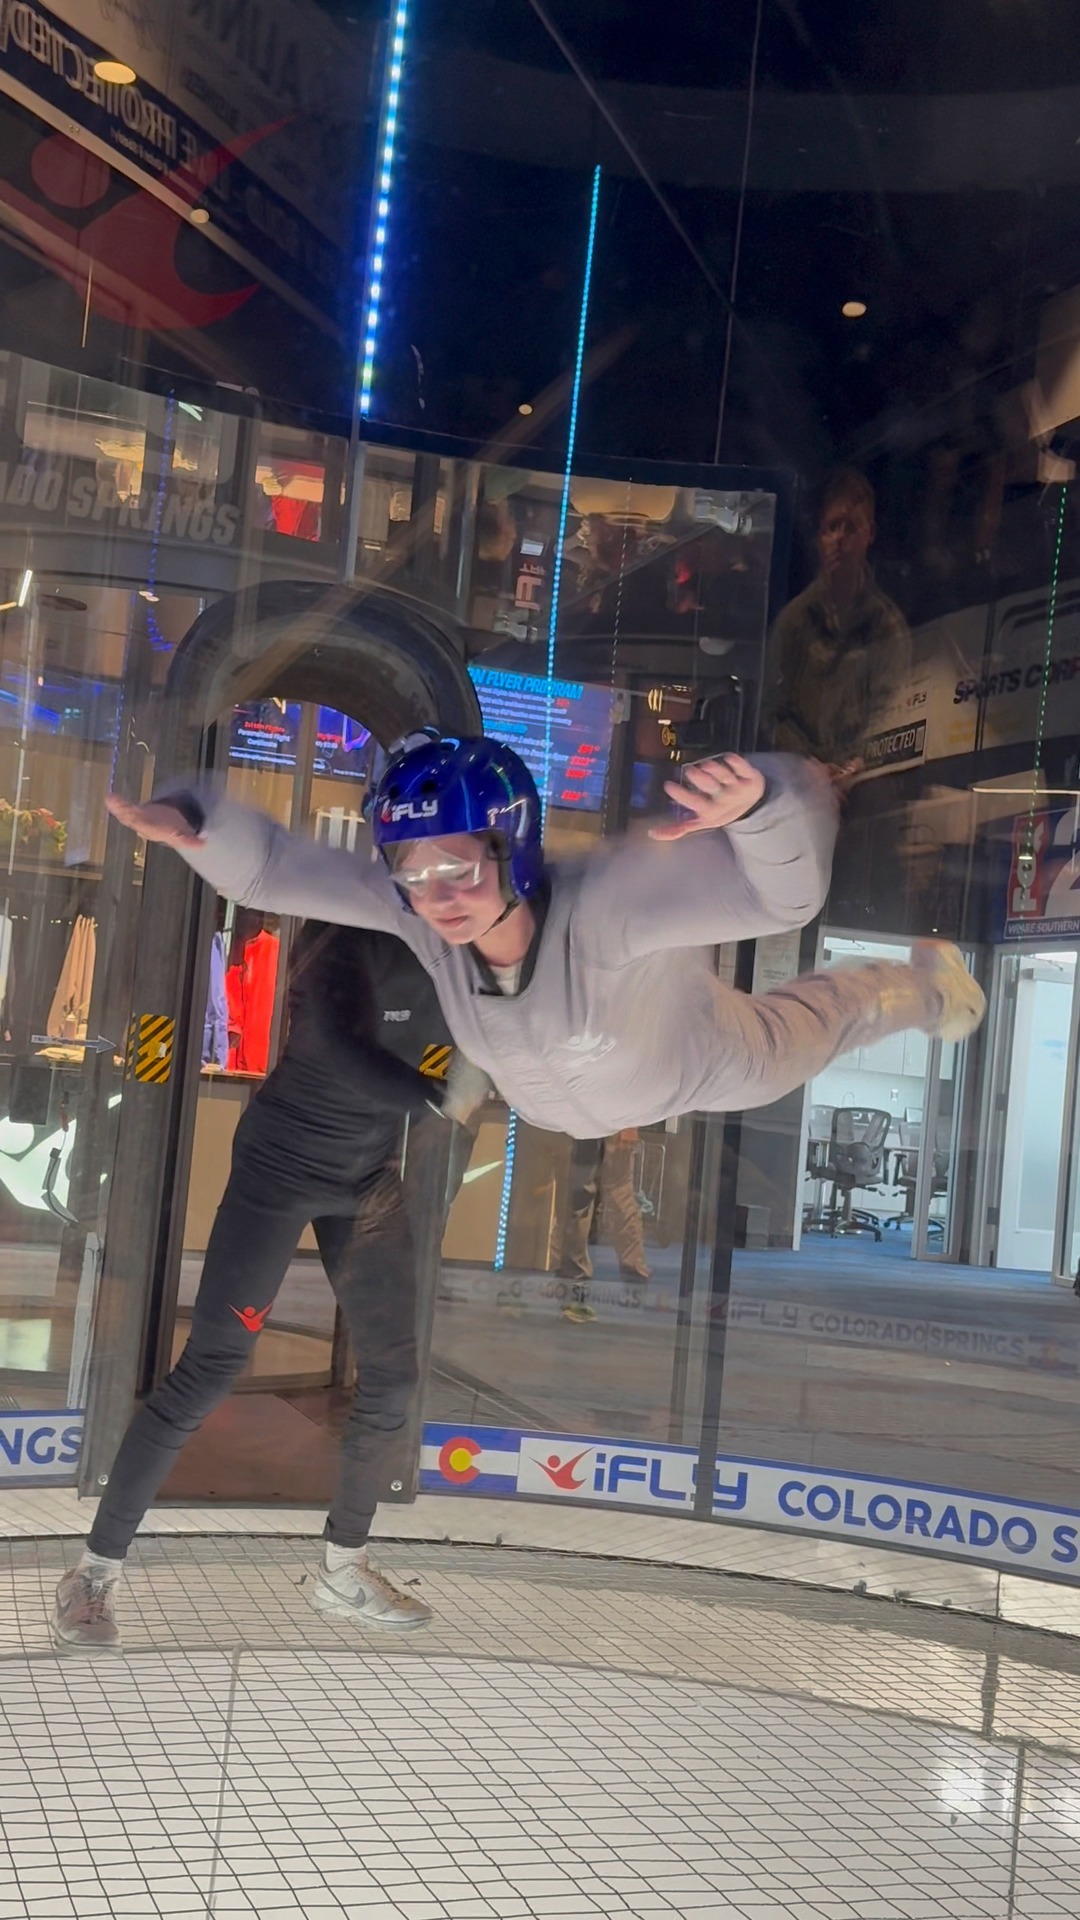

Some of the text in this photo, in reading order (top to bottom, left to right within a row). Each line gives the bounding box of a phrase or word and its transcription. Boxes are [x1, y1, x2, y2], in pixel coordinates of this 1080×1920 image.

[67, 477, 242, 546] SPRINGS
[486, 670, 522, 690] FLYER
[523, 676, 584, 700] PROGRAM
[953, 668, 1022, 705] SPORTS
[865, 728, 916, 760] PROTECTED
[391, 799, 439, 823] iFLY
[1036, 919, 1080, 933] SOUTHERN
[810, 1311, 927, 1345] COLORADO
[929, 1328, 1025, 1358] SPRINGS
[593, 1452, 749, 1512] iFLY
[778, 1480, 1037, 1555] COLORADO
